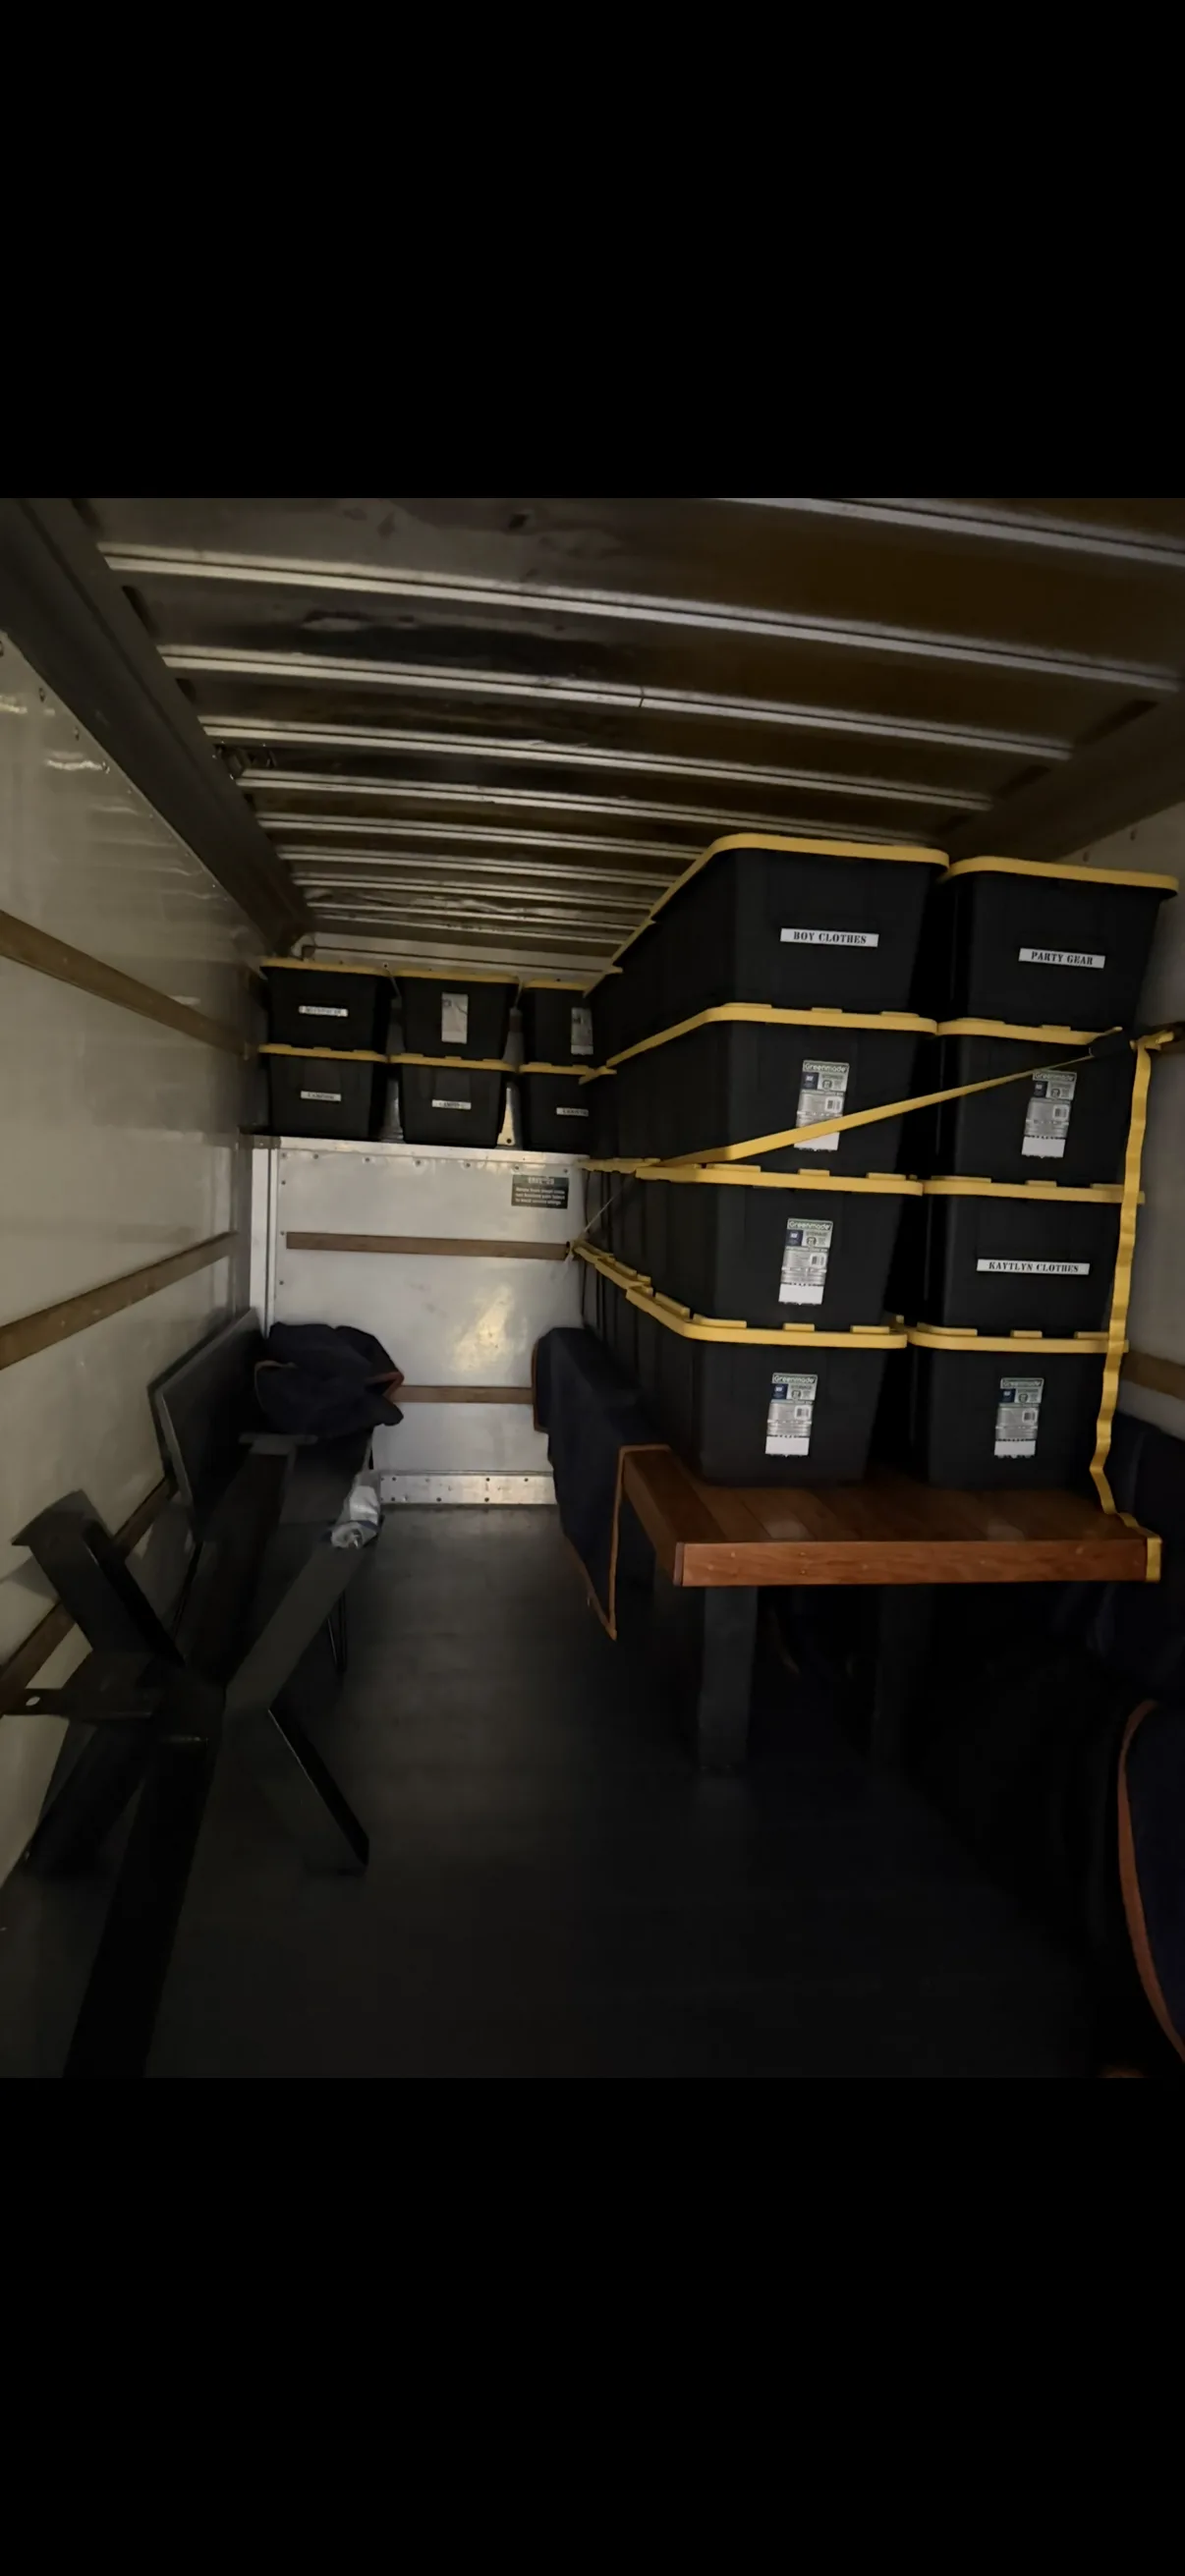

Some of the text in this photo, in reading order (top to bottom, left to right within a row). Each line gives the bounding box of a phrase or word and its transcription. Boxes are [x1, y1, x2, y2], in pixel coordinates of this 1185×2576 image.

[793, 930, 867, 944] BOY CLOTHES
[1032, 950, 1093, 965] PARTY GEAR
[988, 1261, 1079, 1273] KAYTLYN CLOTHES
